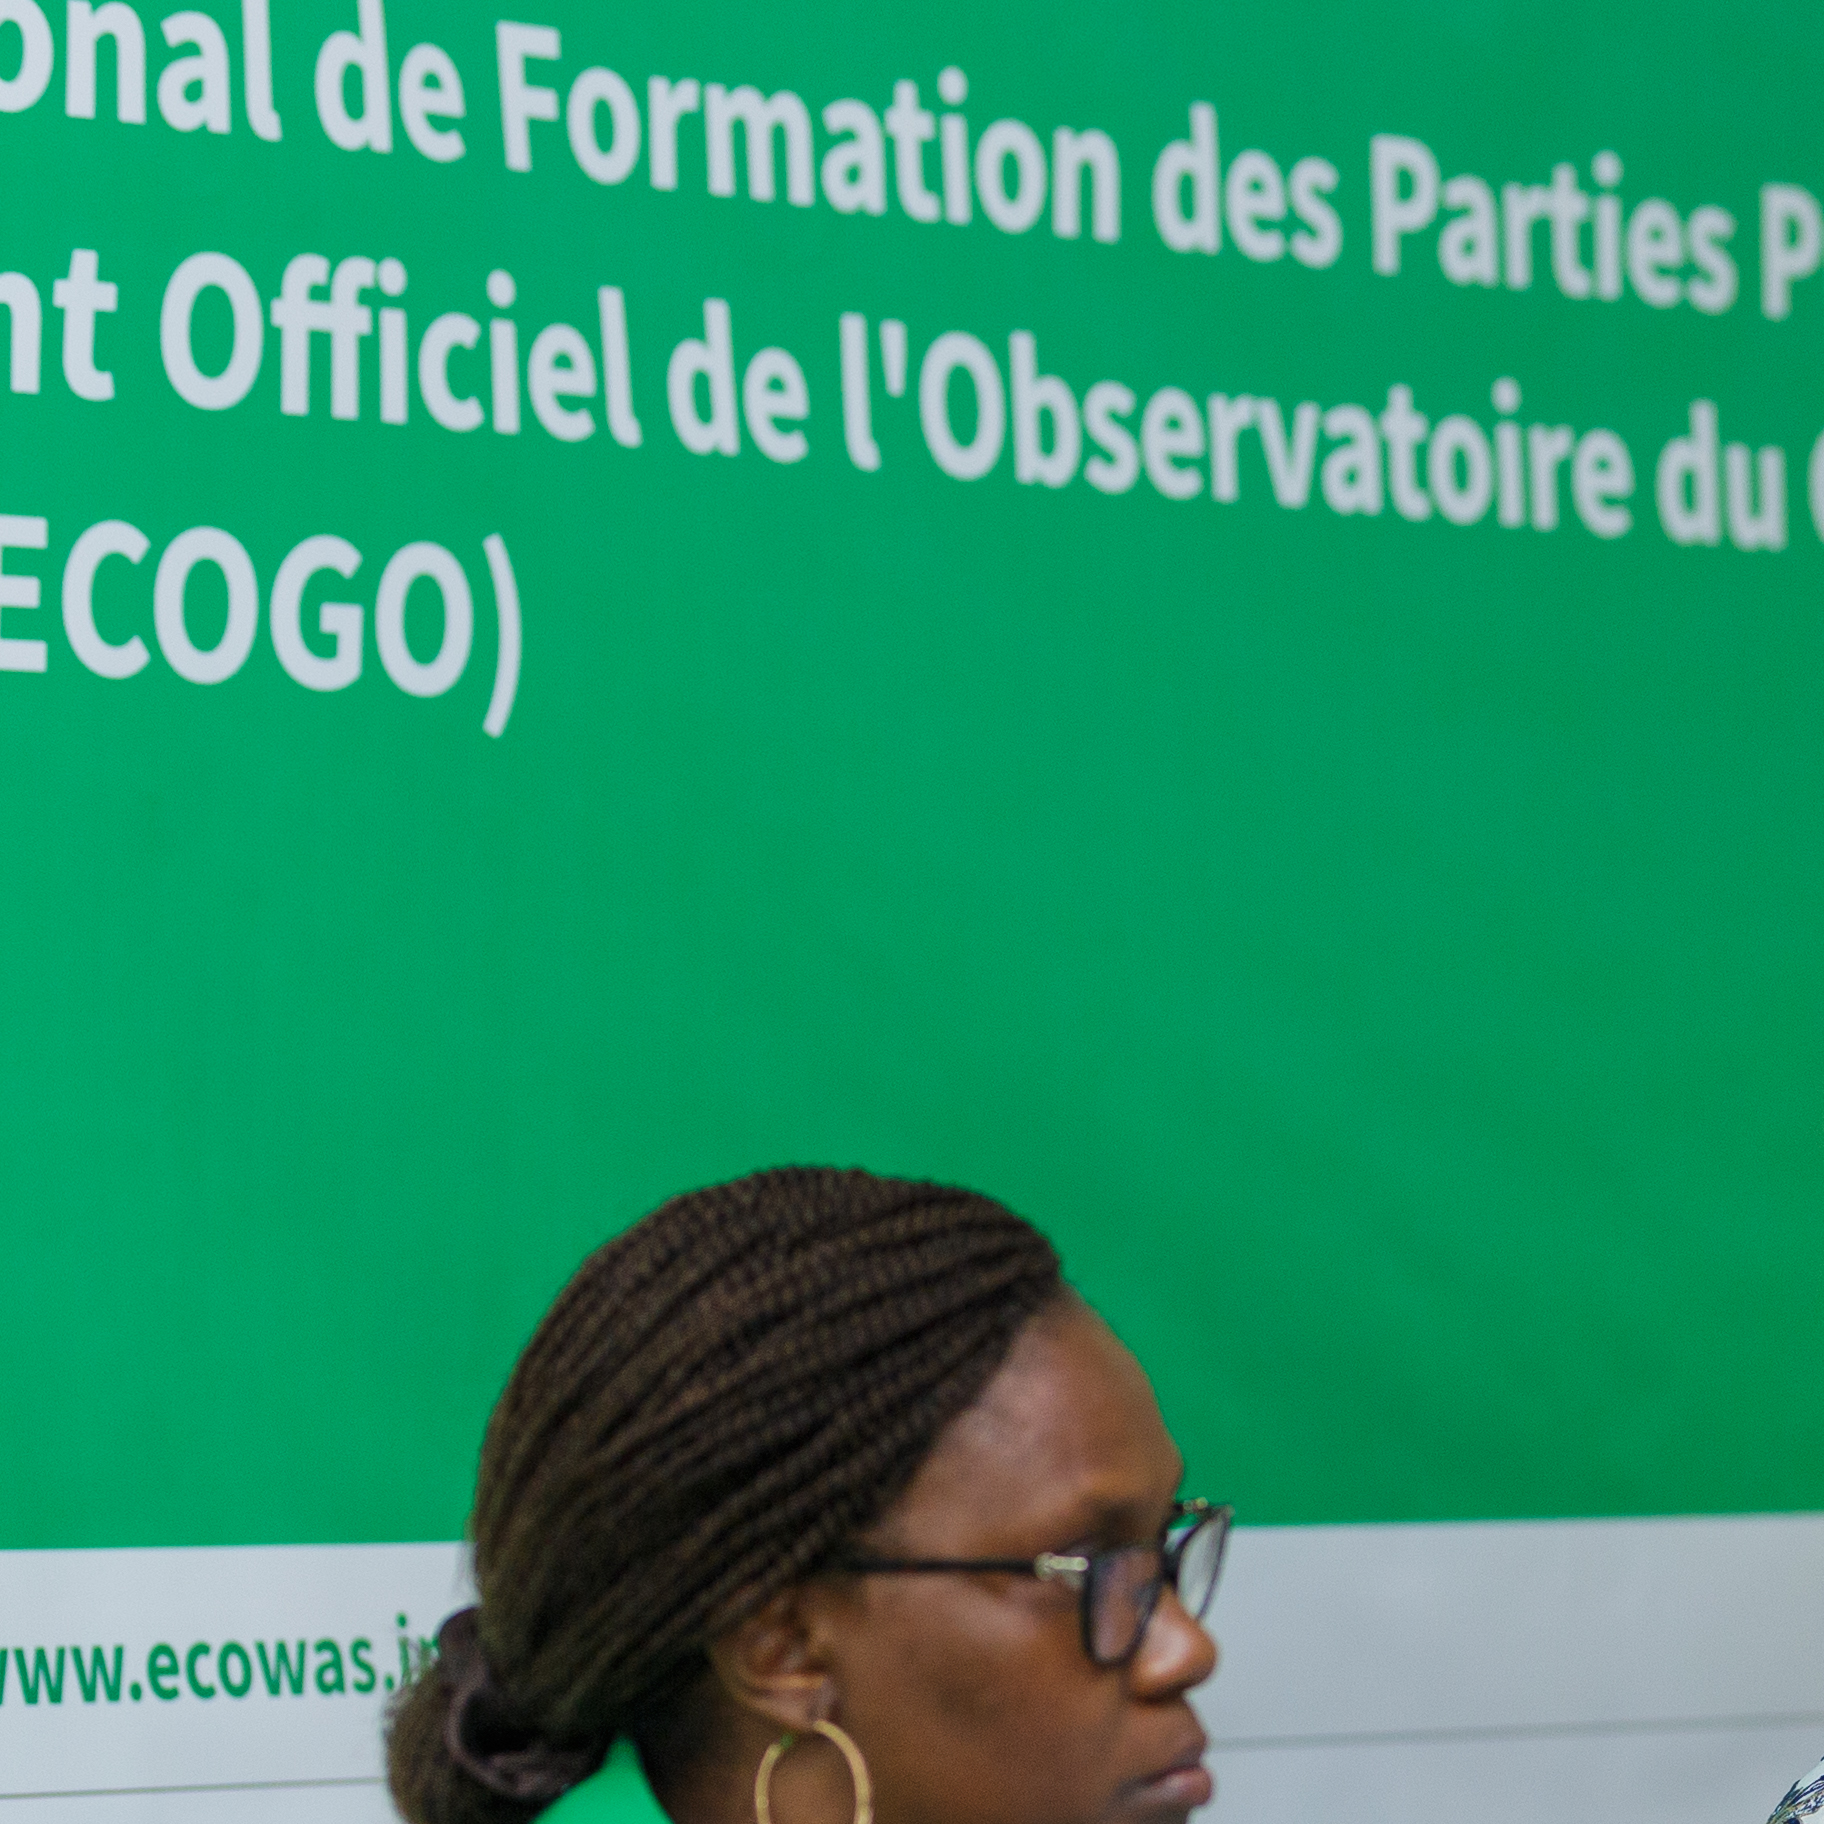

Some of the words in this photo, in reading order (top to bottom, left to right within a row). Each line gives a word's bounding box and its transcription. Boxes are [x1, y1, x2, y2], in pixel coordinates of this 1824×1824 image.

[313, 0, 467, 163] de
[495, 20, 1121, 243] Formation
[1151, 102, 1343, 268] des
[1369, 135, 1737, 313] Parties
[159, 251, 643, 448] Officiel
[666, 298, 810, 463] de
[839, 312, 1634, 538] l'Observatoire
[1656, 400, 1787, 550] du
